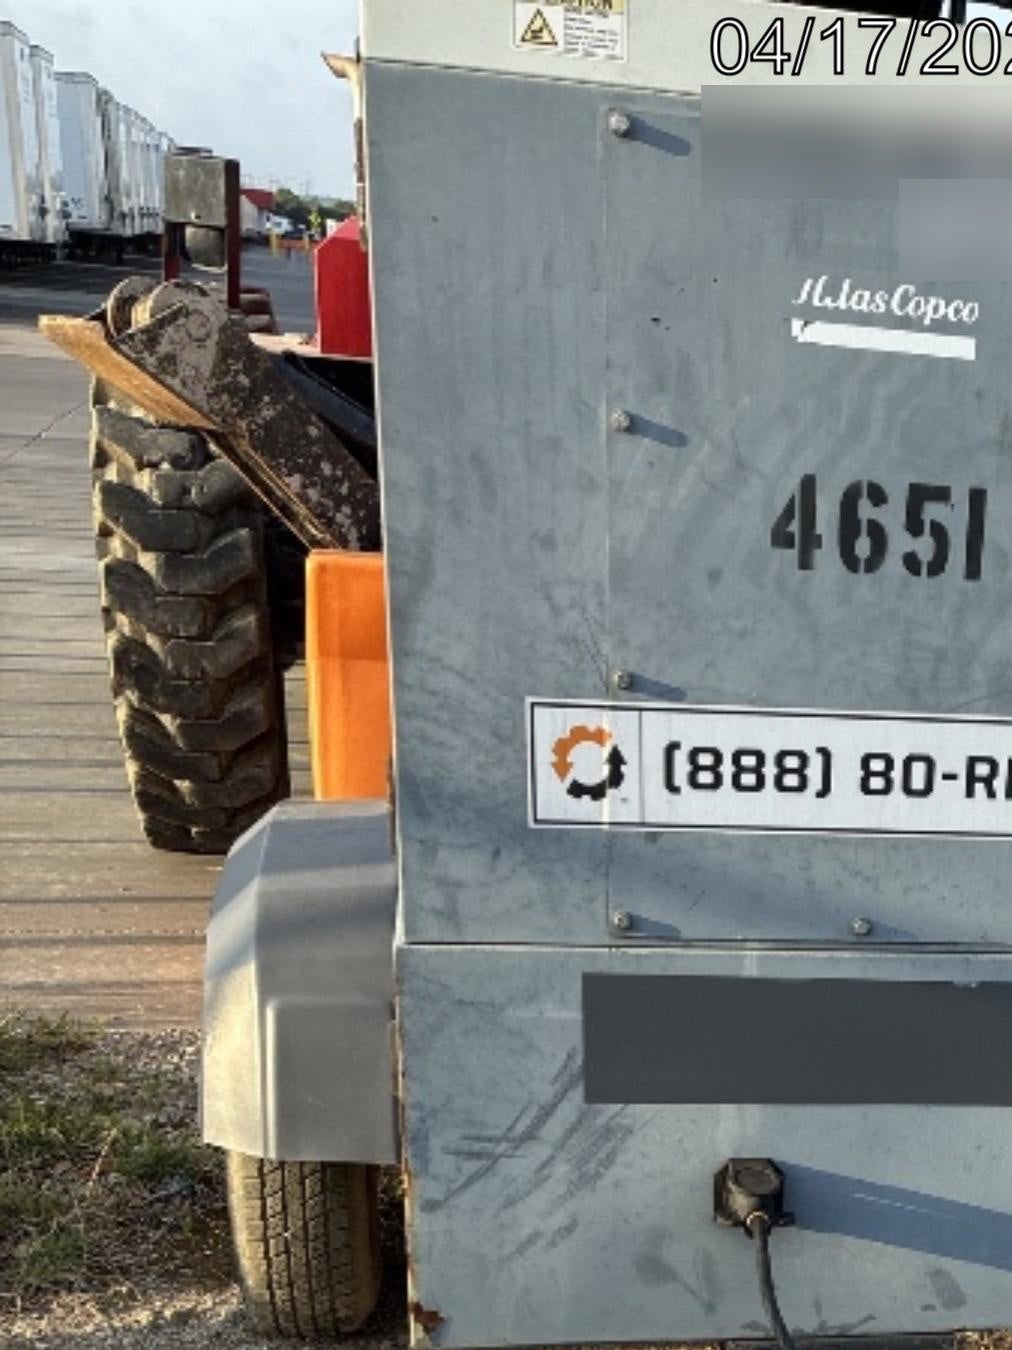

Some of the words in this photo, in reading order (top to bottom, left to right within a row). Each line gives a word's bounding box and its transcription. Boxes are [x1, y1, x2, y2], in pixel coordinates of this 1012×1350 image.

[890, 284, 980, 326] Copco
[771, 474, 987, 581] 4651
[664, 741, 831, 799] (888)
